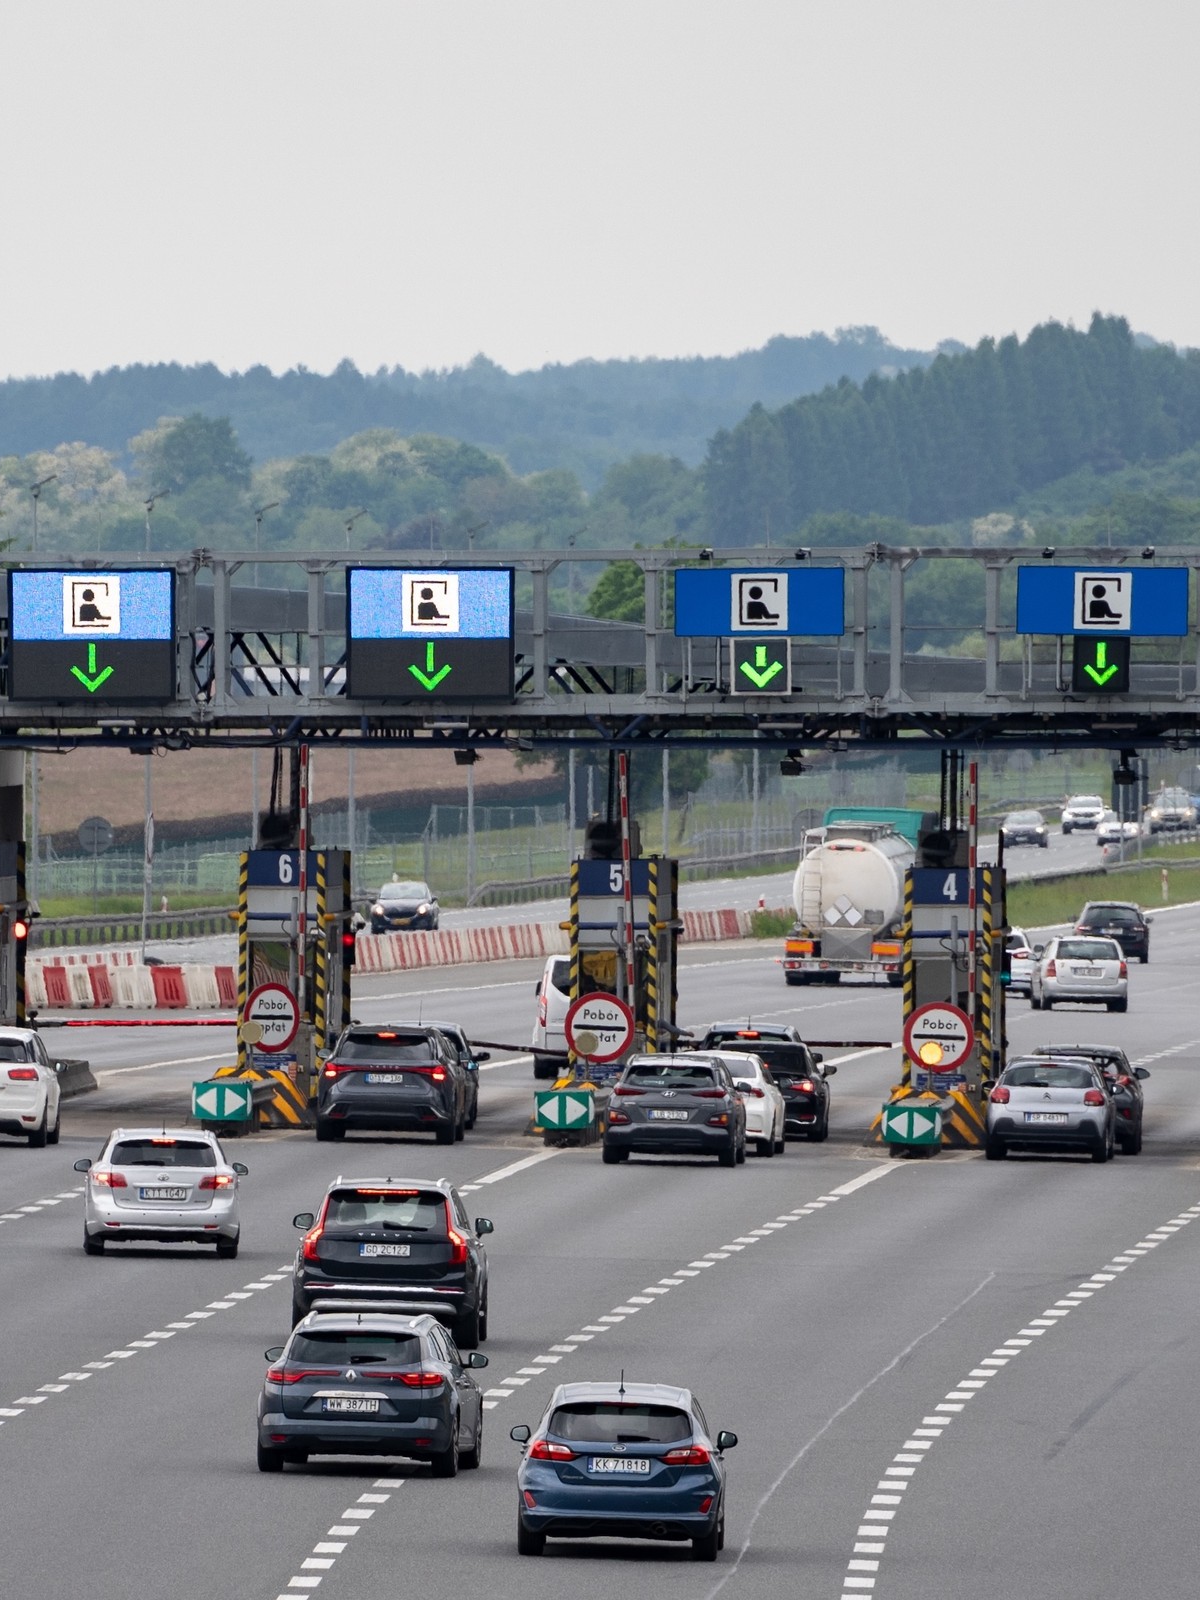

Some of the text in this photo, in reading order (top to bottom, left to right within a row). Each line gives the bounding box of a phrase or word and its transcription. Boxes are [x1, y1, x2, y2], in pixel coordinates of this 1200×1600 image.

[278, 854, 293, 883] 6
[609, 864, 622, 892] 5
[943, 873, 958, 901] 4
[258, 999, 288, 1010] Pobór
[583, 1009, 619, 1021] Pobór
[922, 1018, 958, 1030] Pobór
[366, 1244, 377, 1254] GD
[330, 1400, 377, 1410] WW 387TH
[596, 1459, 647, 1471] KK 71818
